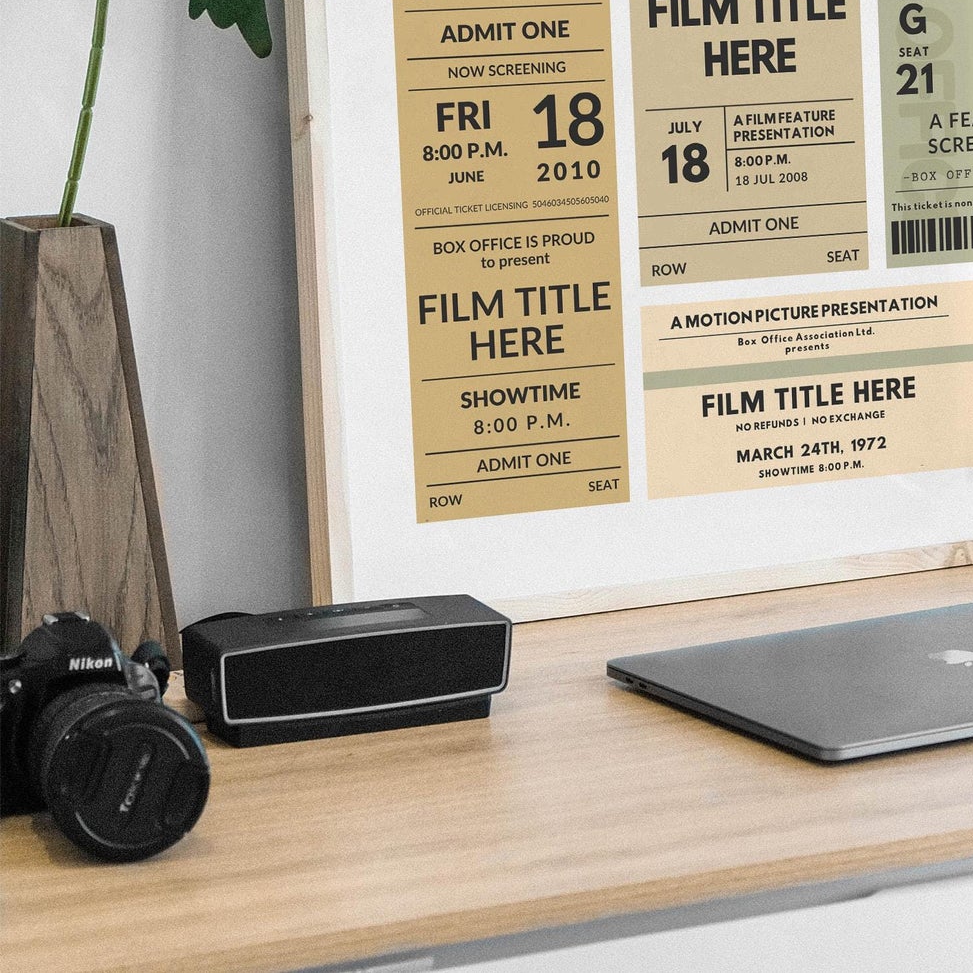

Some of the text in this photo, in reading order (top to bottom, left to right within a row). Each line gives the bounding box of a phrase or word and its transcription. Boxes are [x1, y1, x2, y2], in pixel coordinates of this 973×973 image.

[899, 2, 927, 35] G
[440, 19, 570, 44] ADMIT ONE
[703, 37, 797, 77] HERE
[898, 45, 929, 58] SEAT
[448, 60, 567, 79] NOW SCREENING
[896, 62, 934, 96] 21
[436, 99, 491, 133] FRI
[532, 91, 605, 149] 18
[668, 120, 702, 135] JULY
[929, 113, 943, 130] A
[422, 140, 507, 162] 8:00 P.M.
[734, 153, 791, 168] 8:00 P.M.
[537, 159, 601, 182] 2010
[661, 142, 710, 184] 18
[448, 170, 485, 185] JUNE
[414, 206, 453, 217] OFFICIAL
[454, 203, 483, 214] TICKET
[484, 200, 529, 212] LICENSING
[433, 231, 596, 255] BOX OFFICE IS PROUD
[480, 252, 550, 270] to present
[418, 281, 612, 325] FILM TITLE
[670, 295, 938, 330] A MOTION PICTURE PRESENTATION
[470, 324, 565, 361] HERE
[737, 326, 875, 347] Box Office Association Ltd.
[784, 342, 830, 356] presents
[460, 381, 581, 409] SHOWTIME
[701, 375, 916, 418] FILM TITLE HERE
[473, 412, 569, 435] 8:00 P.M.
[736, 435, 887, 464] MARCH 24TH, 1972
[758, 459, 865, 479] SHOWTIME 8:00 P.M.
[69, 657, 113, 670] Nikon
